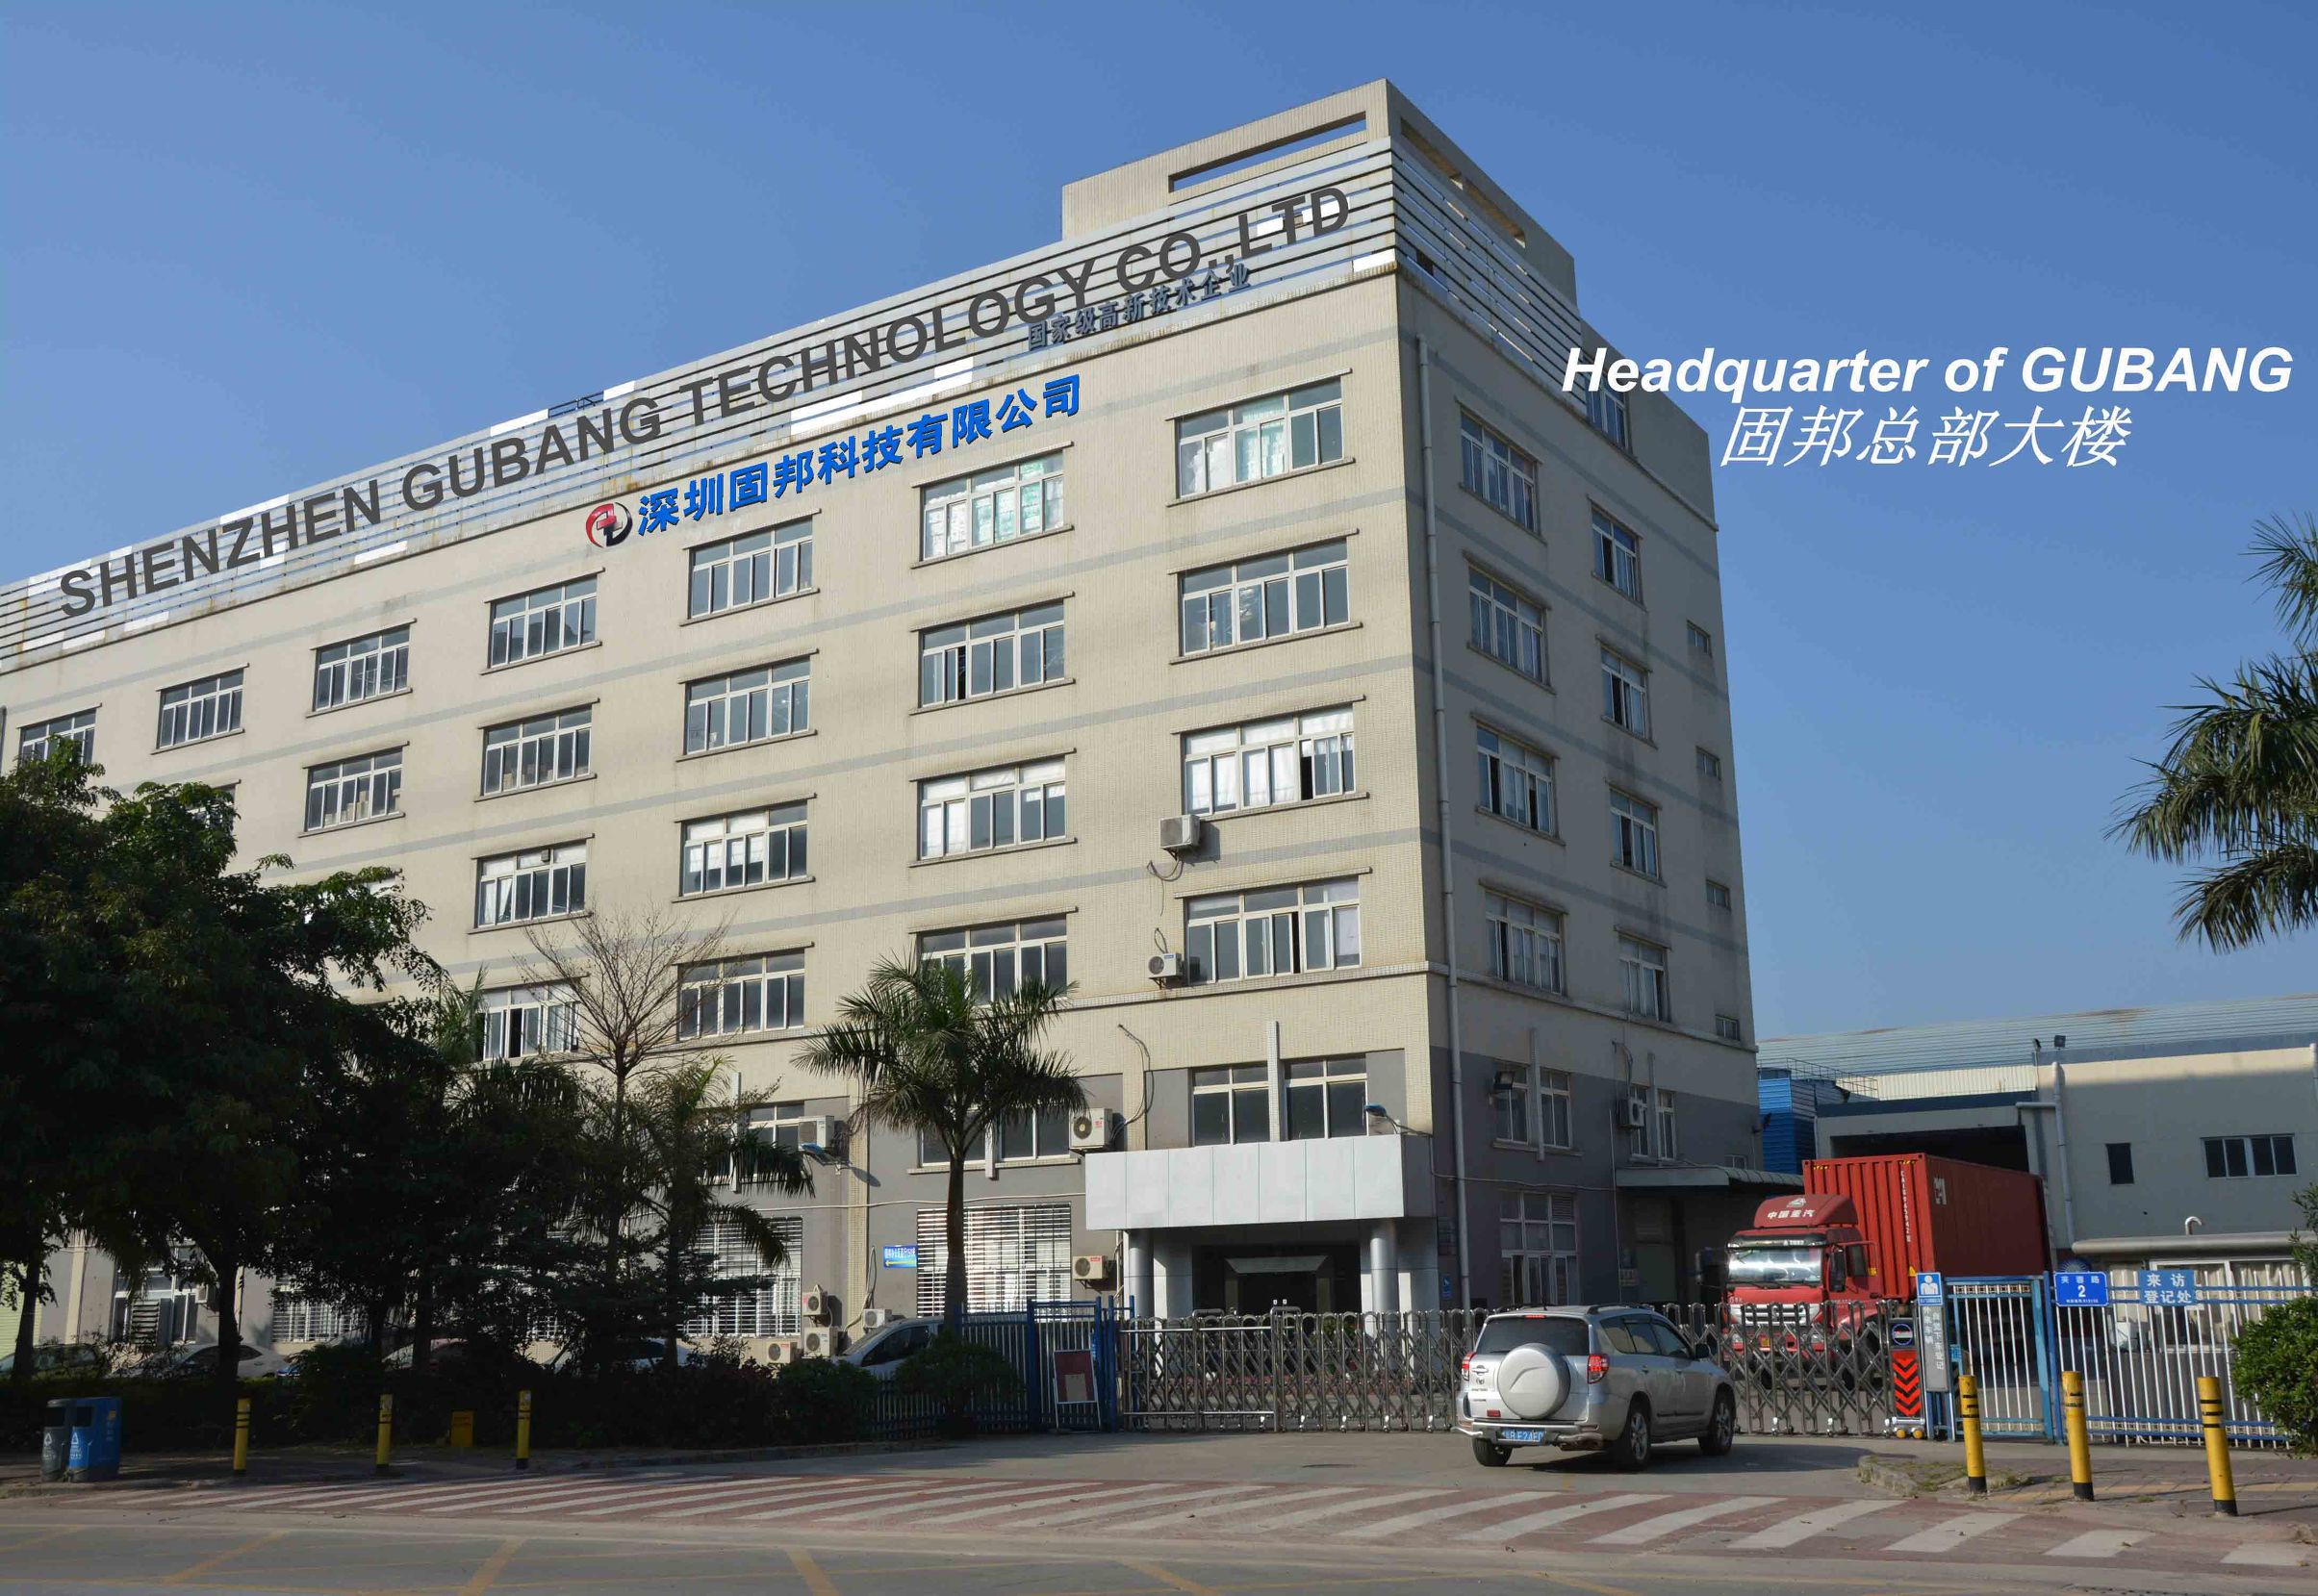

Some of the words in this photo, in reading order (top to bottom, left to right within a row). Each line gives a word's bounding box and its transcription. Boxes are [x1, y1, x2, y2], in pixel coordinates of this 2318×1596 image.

[1028, 264, 1252, 351] 国家级高新技术企业
[60, 479, 381, 618] SHENZHEN
[401, 396, 662, 512] GUBANG
[680, 257, 1097, 426] TECHNOLOGY
[637, 374, 1081, 536] 深圳固邦科技有限公司
[1767, 1209, 1816, 1219] 中国重汽
[2146, 1273, 2185, 1287] 来访
[2077, 1284, 2086, 1298] 2
[2144, 1290, 2192, 1305] 登记处
